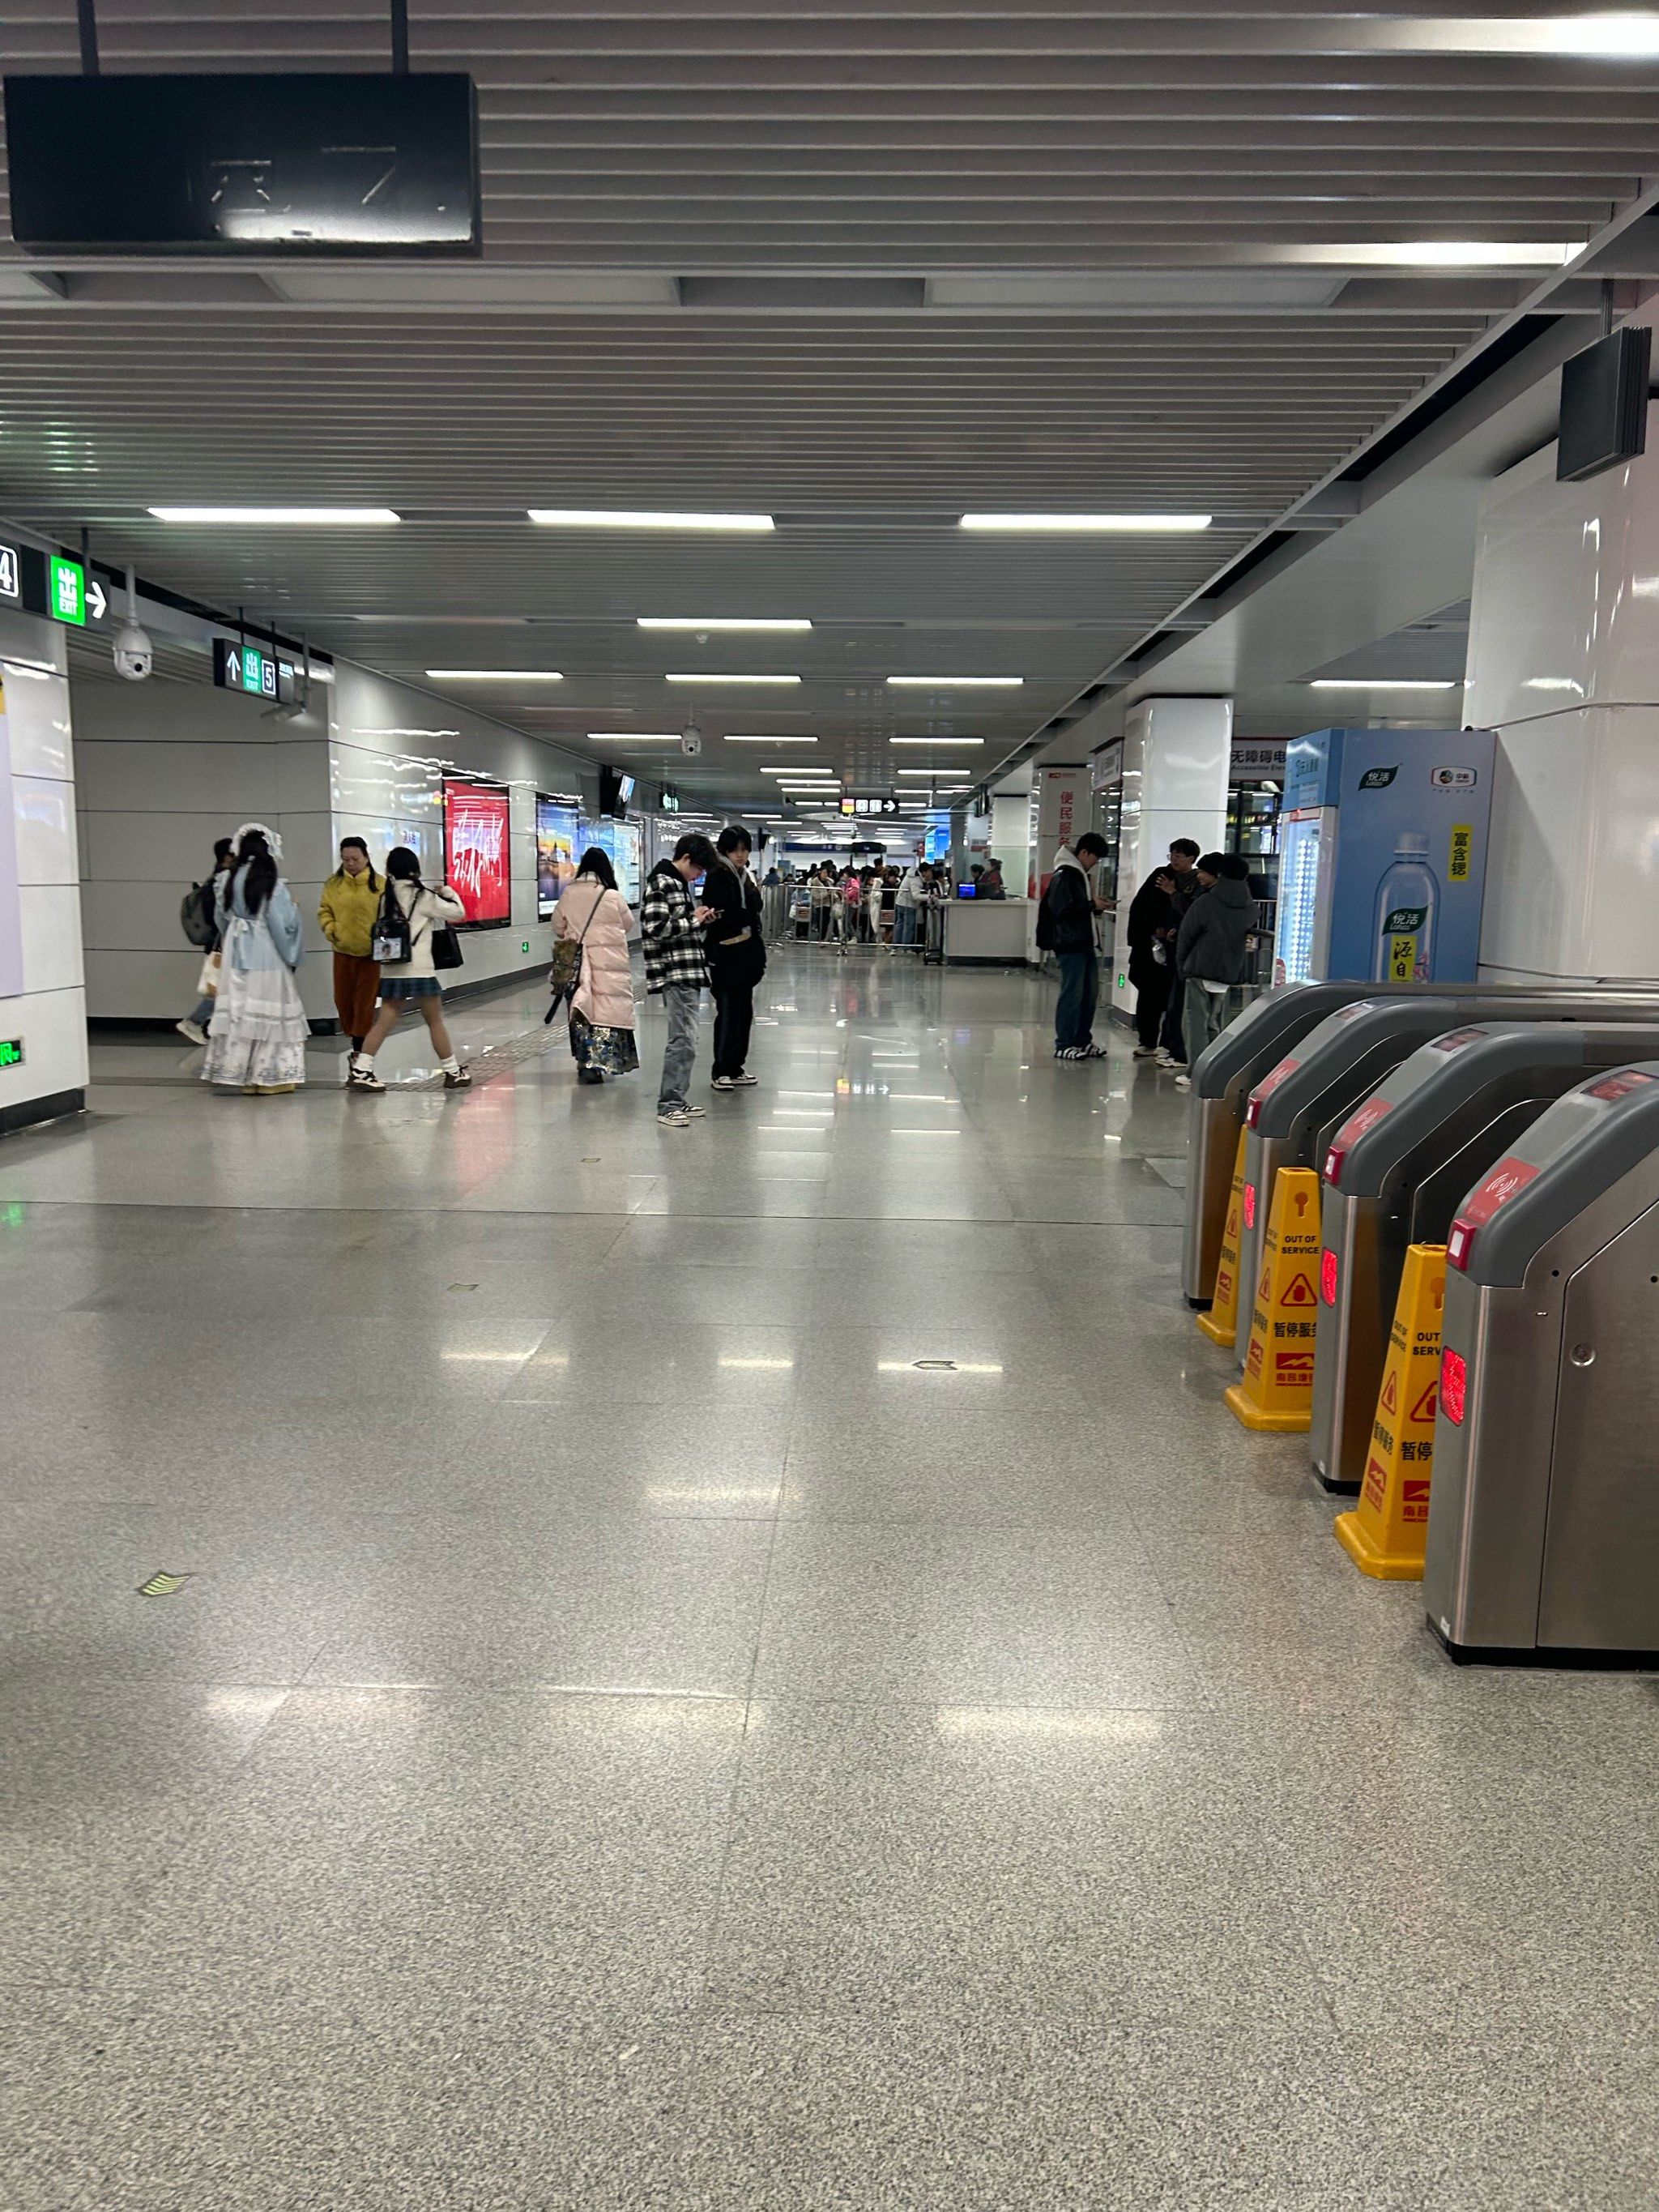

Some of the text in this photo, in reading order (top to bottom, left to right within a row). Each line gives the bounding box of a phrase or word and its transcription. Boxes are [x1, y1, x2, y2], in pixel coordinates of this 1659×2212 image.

[0, 552, 12, 590] 4
[58, 567, 77, 602] 出
[59, 596, 79, 616] EXIT
[245, 652, 258, 681] 出
[265, 667, 272, 688] 5
[1393, 913, 1419, 925] 悦活
[1285, 1235, 1317, 1243] OUT OF
[1282, 1246, 1320, 1254] SERVICE
[1417, 1332, 1440, 1342] OUT
[1401, 1441, 1434, 1461] 暂停
